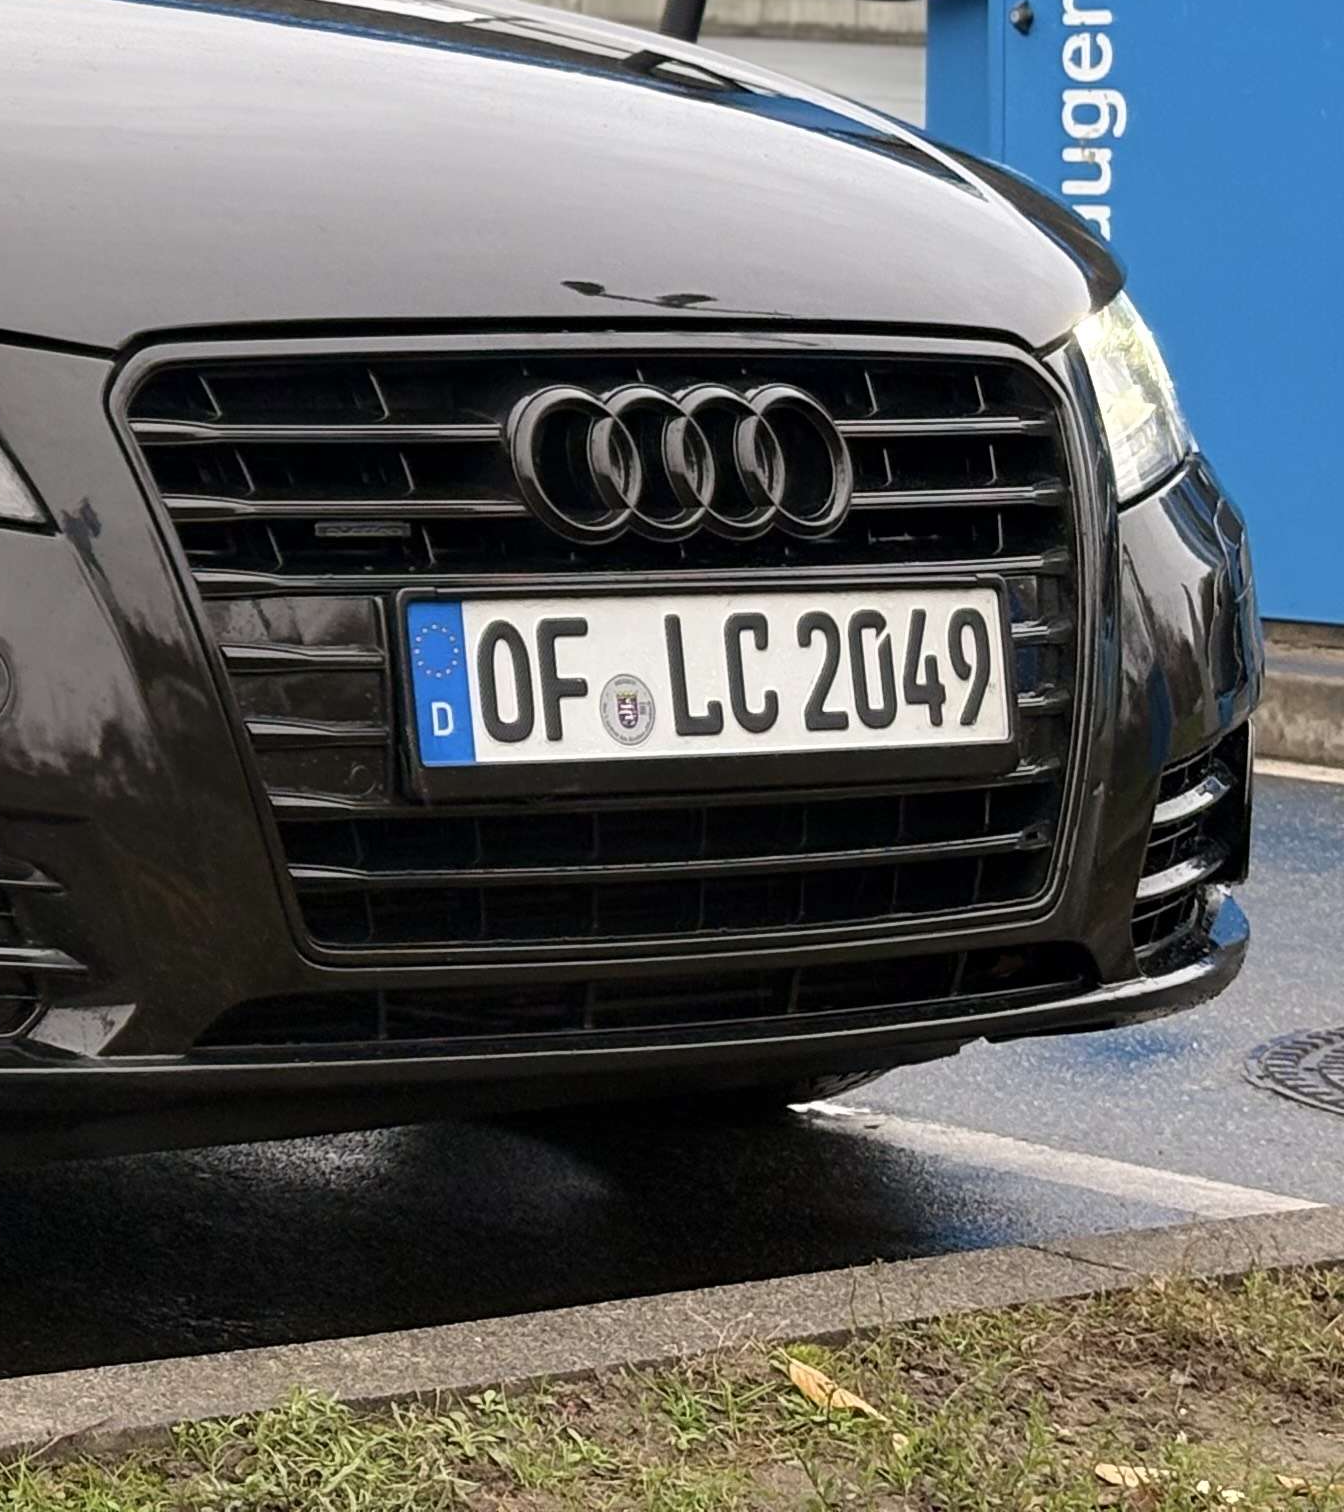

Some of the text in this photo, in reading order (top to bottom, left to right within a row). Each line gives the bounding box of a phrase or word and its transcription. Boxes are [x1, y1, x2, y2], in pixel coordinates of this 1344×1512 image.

[476, 618, 588, 743] OF
[664, 611, 780, 737] LC
[796, 607, 991, 731] 2049
[431, 701, 454, 737] D
